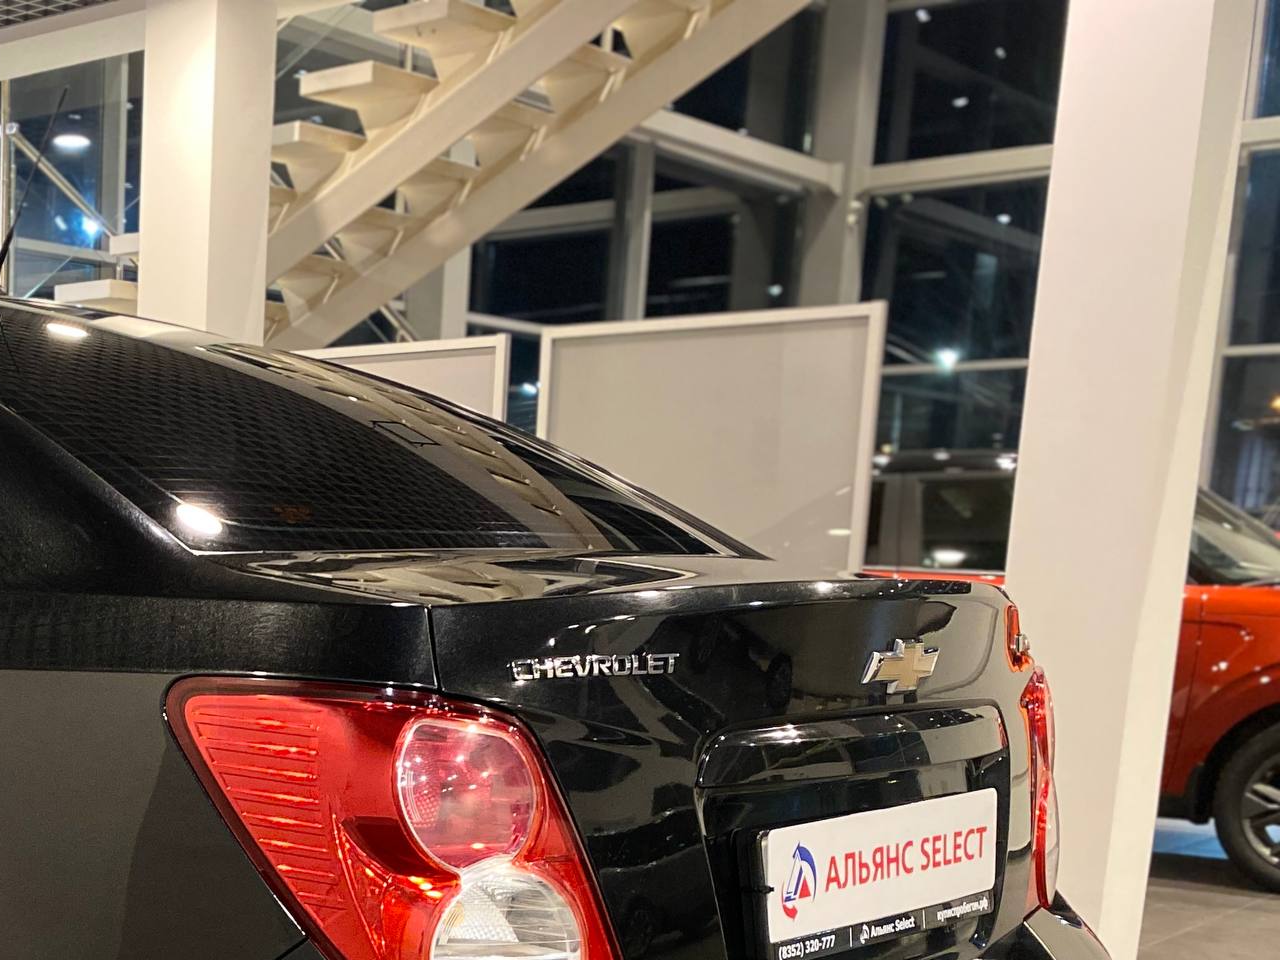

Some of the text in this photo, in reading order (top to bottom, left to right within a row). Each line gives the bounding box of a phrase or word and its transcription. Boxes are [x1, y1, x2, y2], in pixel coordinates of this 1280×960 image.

[511, 653, 680, 681] CHEVROLET
[824, 825, 988, 892] АЛЬЯНС SELECT
[870, 916, 916, 938] Альянс Select
[805, 934, 836, 954] 320-777
